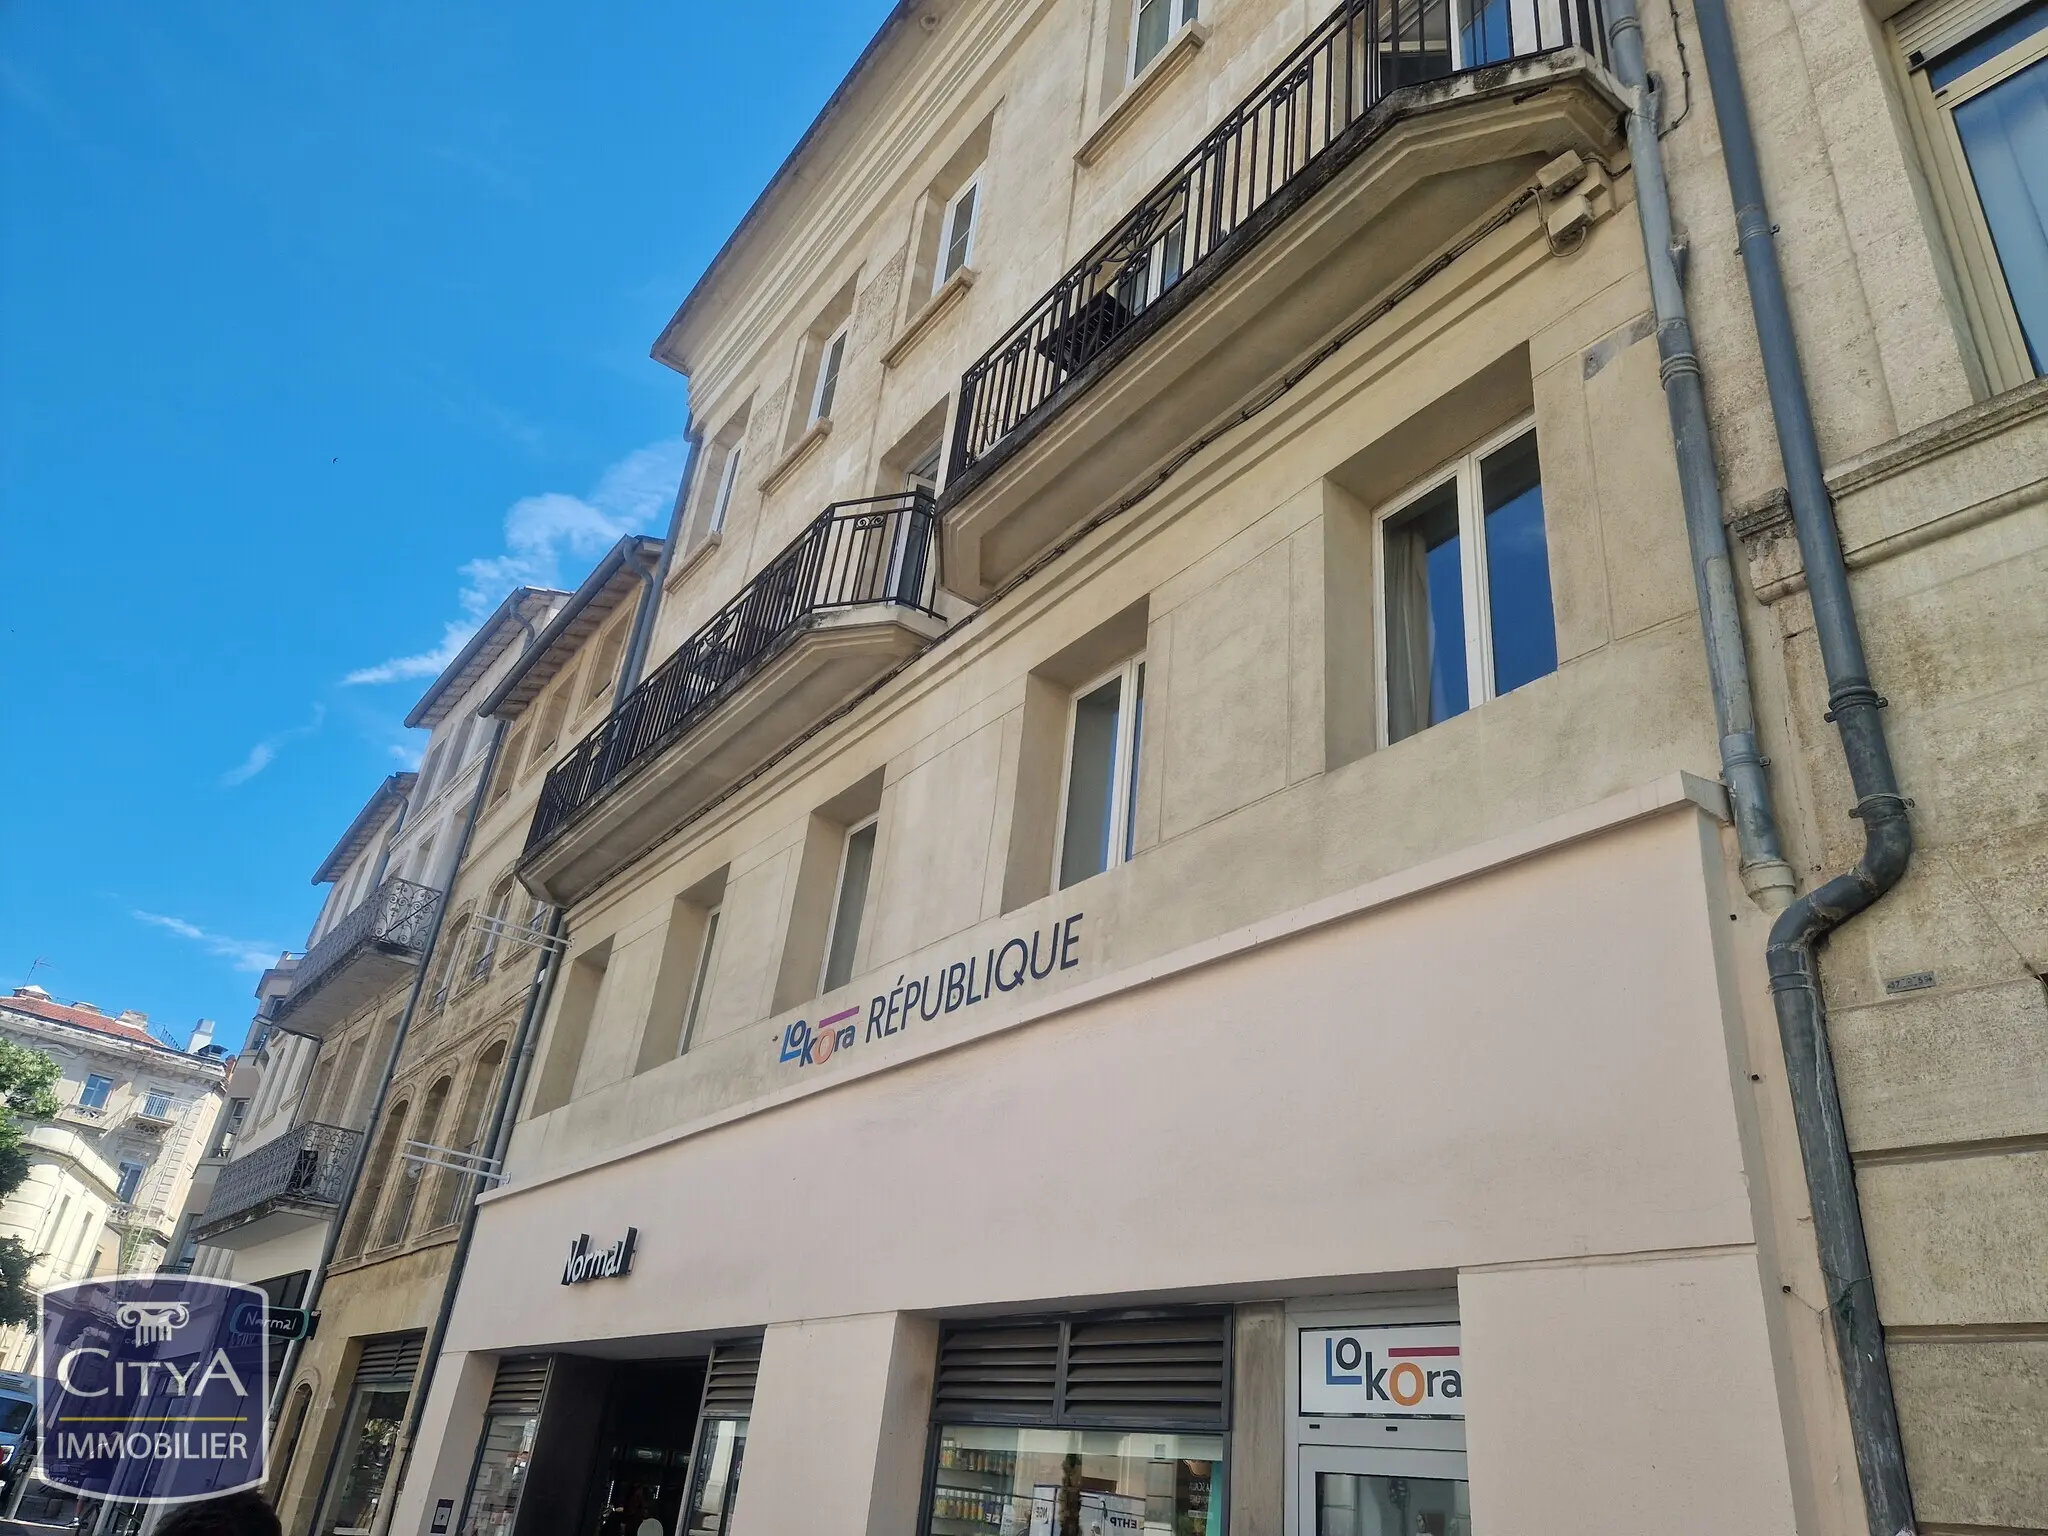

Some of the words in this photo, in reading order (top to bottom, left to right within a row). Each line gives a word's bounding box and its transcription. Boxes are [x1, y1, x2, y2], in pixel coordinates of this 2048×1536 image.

[866, 913, 1083, 1043] RÉPUBLIQUE
[561, 1226, 637, 1285] Normal
[244, 1311, 297, 1331] Normal
